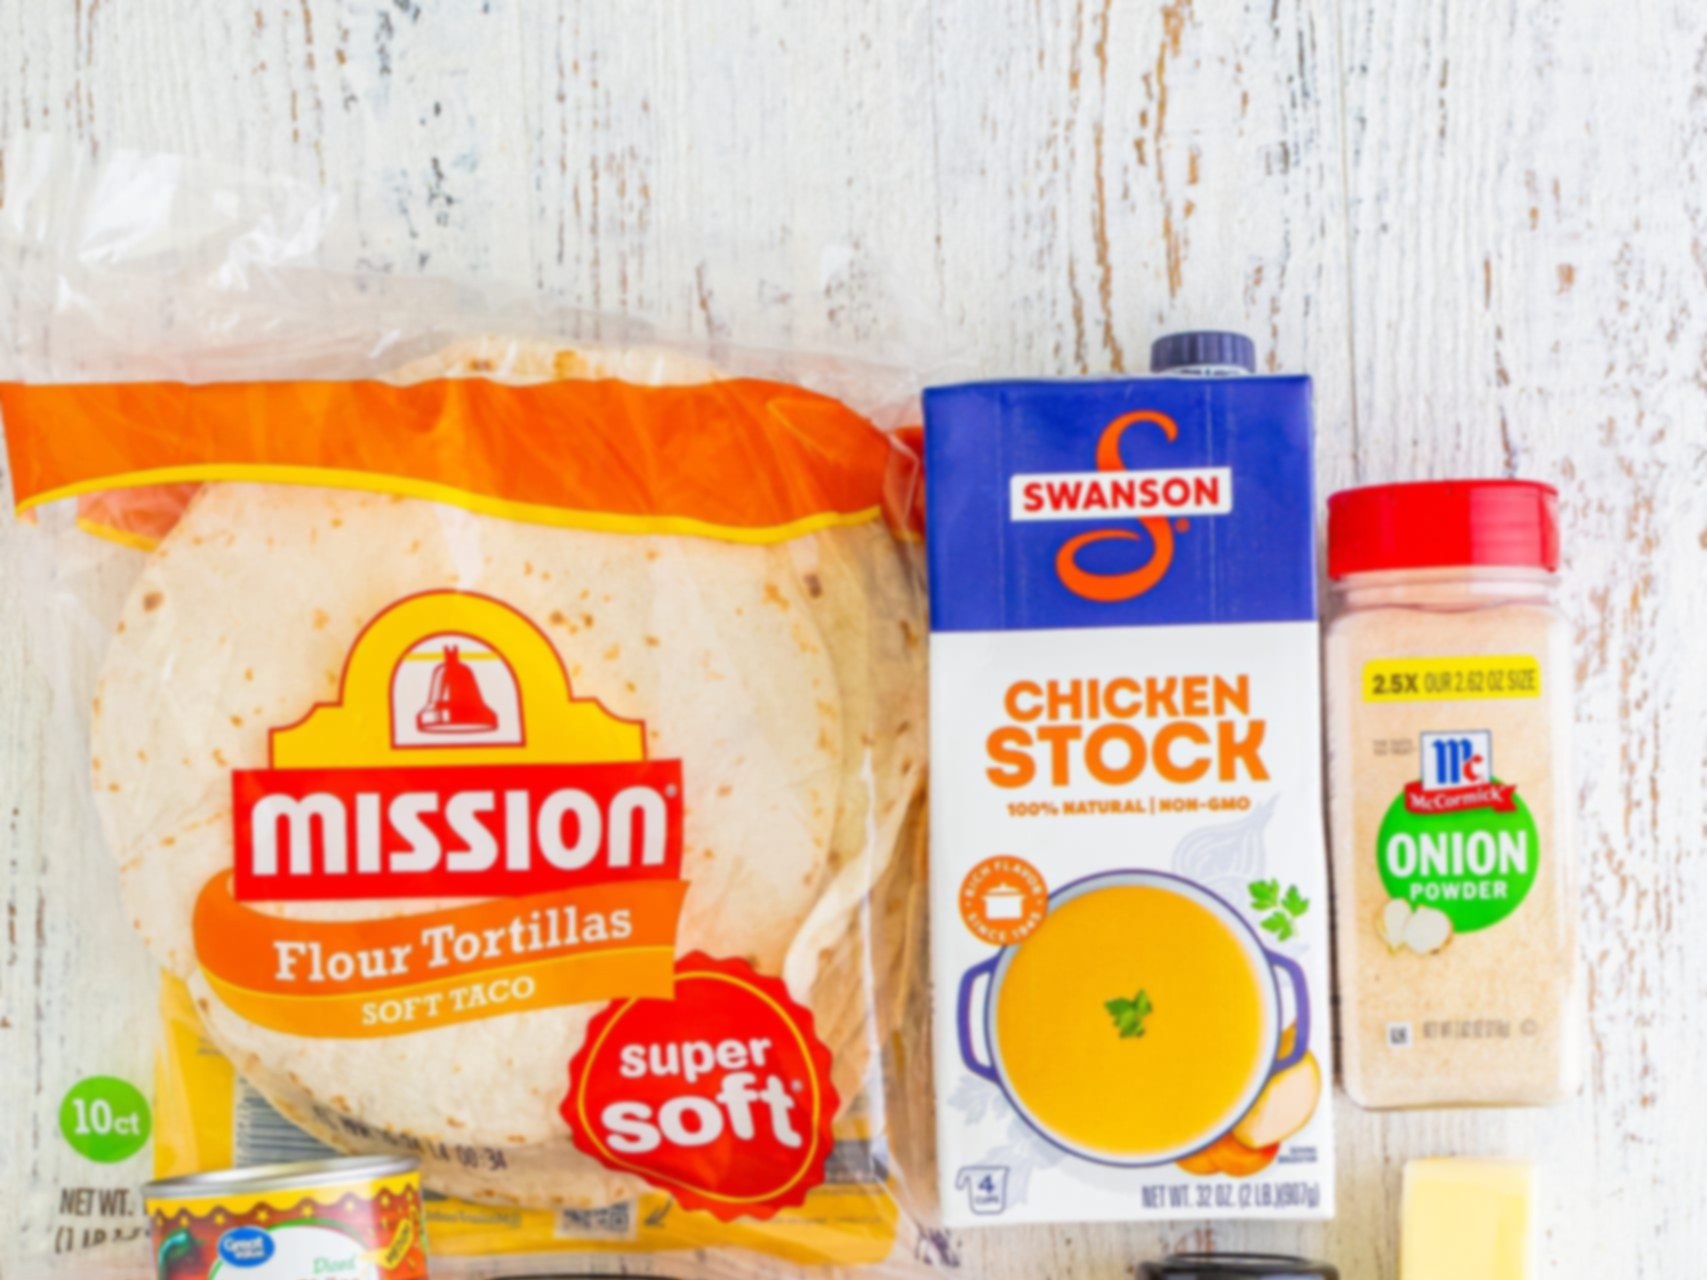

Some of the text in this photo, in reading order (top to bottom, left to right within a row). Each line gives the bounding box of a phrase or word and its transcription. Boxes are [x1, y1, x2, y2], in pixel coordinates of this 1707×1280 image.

[1023, 476, 1219, 512] SWANSON
[1004, 674, 1249, 722] CHICKEN
[1372, 674, 1419, 694] 2.5X
[1424, 672, 1450, 693] OUR
[1508, 669, 1536, 690] SIZE
[985, 719, 1271, 789] STOCK
[1007, 796, 1250, 816] 100% NATURAL NON-GMO
[1410, 788, 1502, 810] McCormick
[251, 785, 667, 877] MISSION
[1386, 830, 1527, 877] ONION
[1410, 880, 1507, 900] POWDER
[274, 903, 633, 982] Flour Tortillas
[361, 975, 536, 1026] SOFT TACO
[619, 1037, 773, 1083] super
[601, 1073, 803, 1154] soft
[60, 1187, 94, 1216] NET
[979, 1175, 996, 1194] 4
[1142, 1185, 1166, 1208] NET
[1196, 1184, 1212, 1206] 32
[224, 1236, 265, 1252] Great
